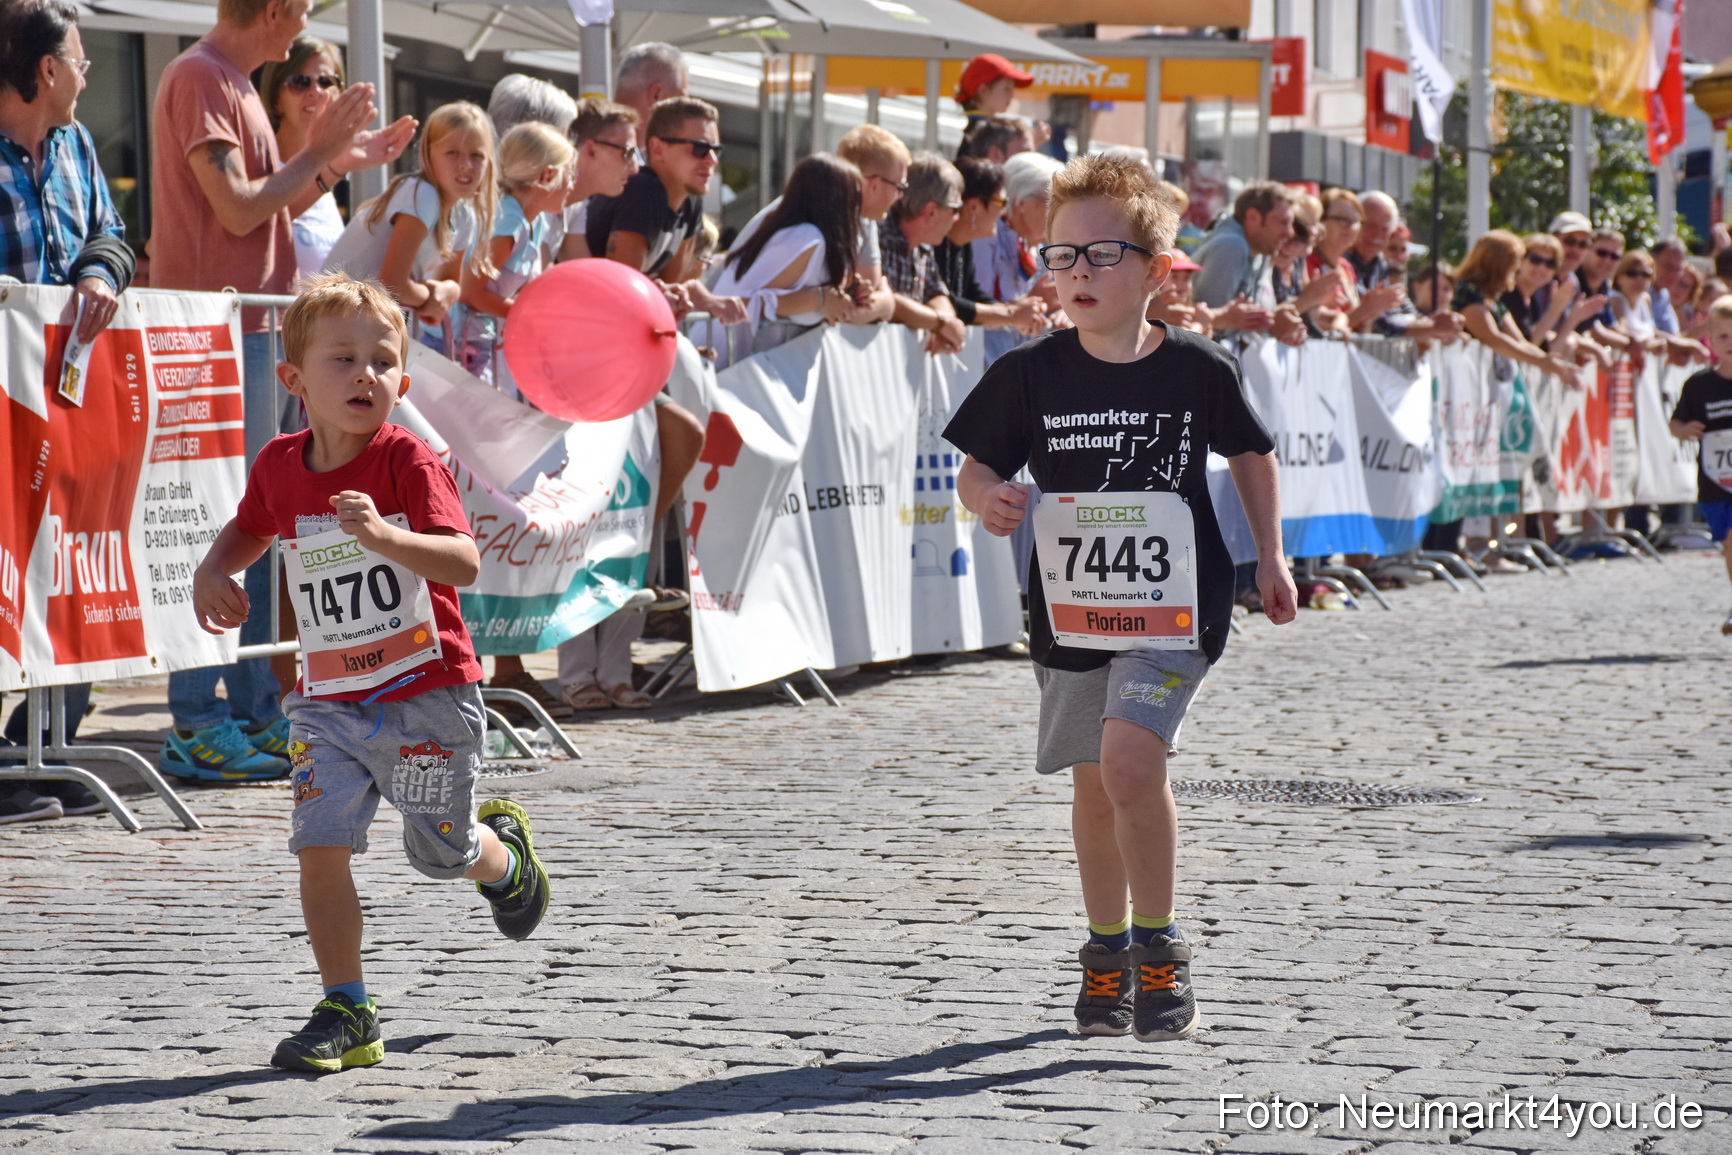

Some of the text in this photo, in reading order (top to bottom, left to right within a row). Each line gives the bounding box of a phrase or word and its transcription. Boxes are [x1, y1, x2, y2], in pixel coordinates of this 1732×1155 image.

[148, 331, 212, 352] BINDESTRICKE
[125, 353, 141, 422] Seit 1929
[1042, 408, 1149, 430] Neumarkter
[1048, 431, 1126, 453] Stadtlauf
[30, 440, 51, 491] Seit 1929
[144, 481, 193, 501] Braun GmbH
[143, 504, 208, 526] Am Grünberg 8
[1077, 506, 1147, 522] BOCK
[144, 524, 222, 549] D-92318 Neumar
[48, 515, 128, 597] Braun
[300, 540, 364, 568] BOCK
[341, 556, 367, 566] concepts
[1058, 535, 1171, 583] 7443
[148, 564, 165, 582] Tel.
[1047, 571, 1057, 581] B2
[151, 584, 194, 606] Fax 0918
[299, 564, 402, 627] 7470
[1072, 590, 1148, 600] PARTL Neumarkt
[322, 622, 387, 643] PARTL Neumarkt
[1086, 611, 1146, 632] Florian
[340, 648, 385, 673] Xaver
[391, 783, 454, 804] RUFF
[393, 802, 454, 816] Rescue!
